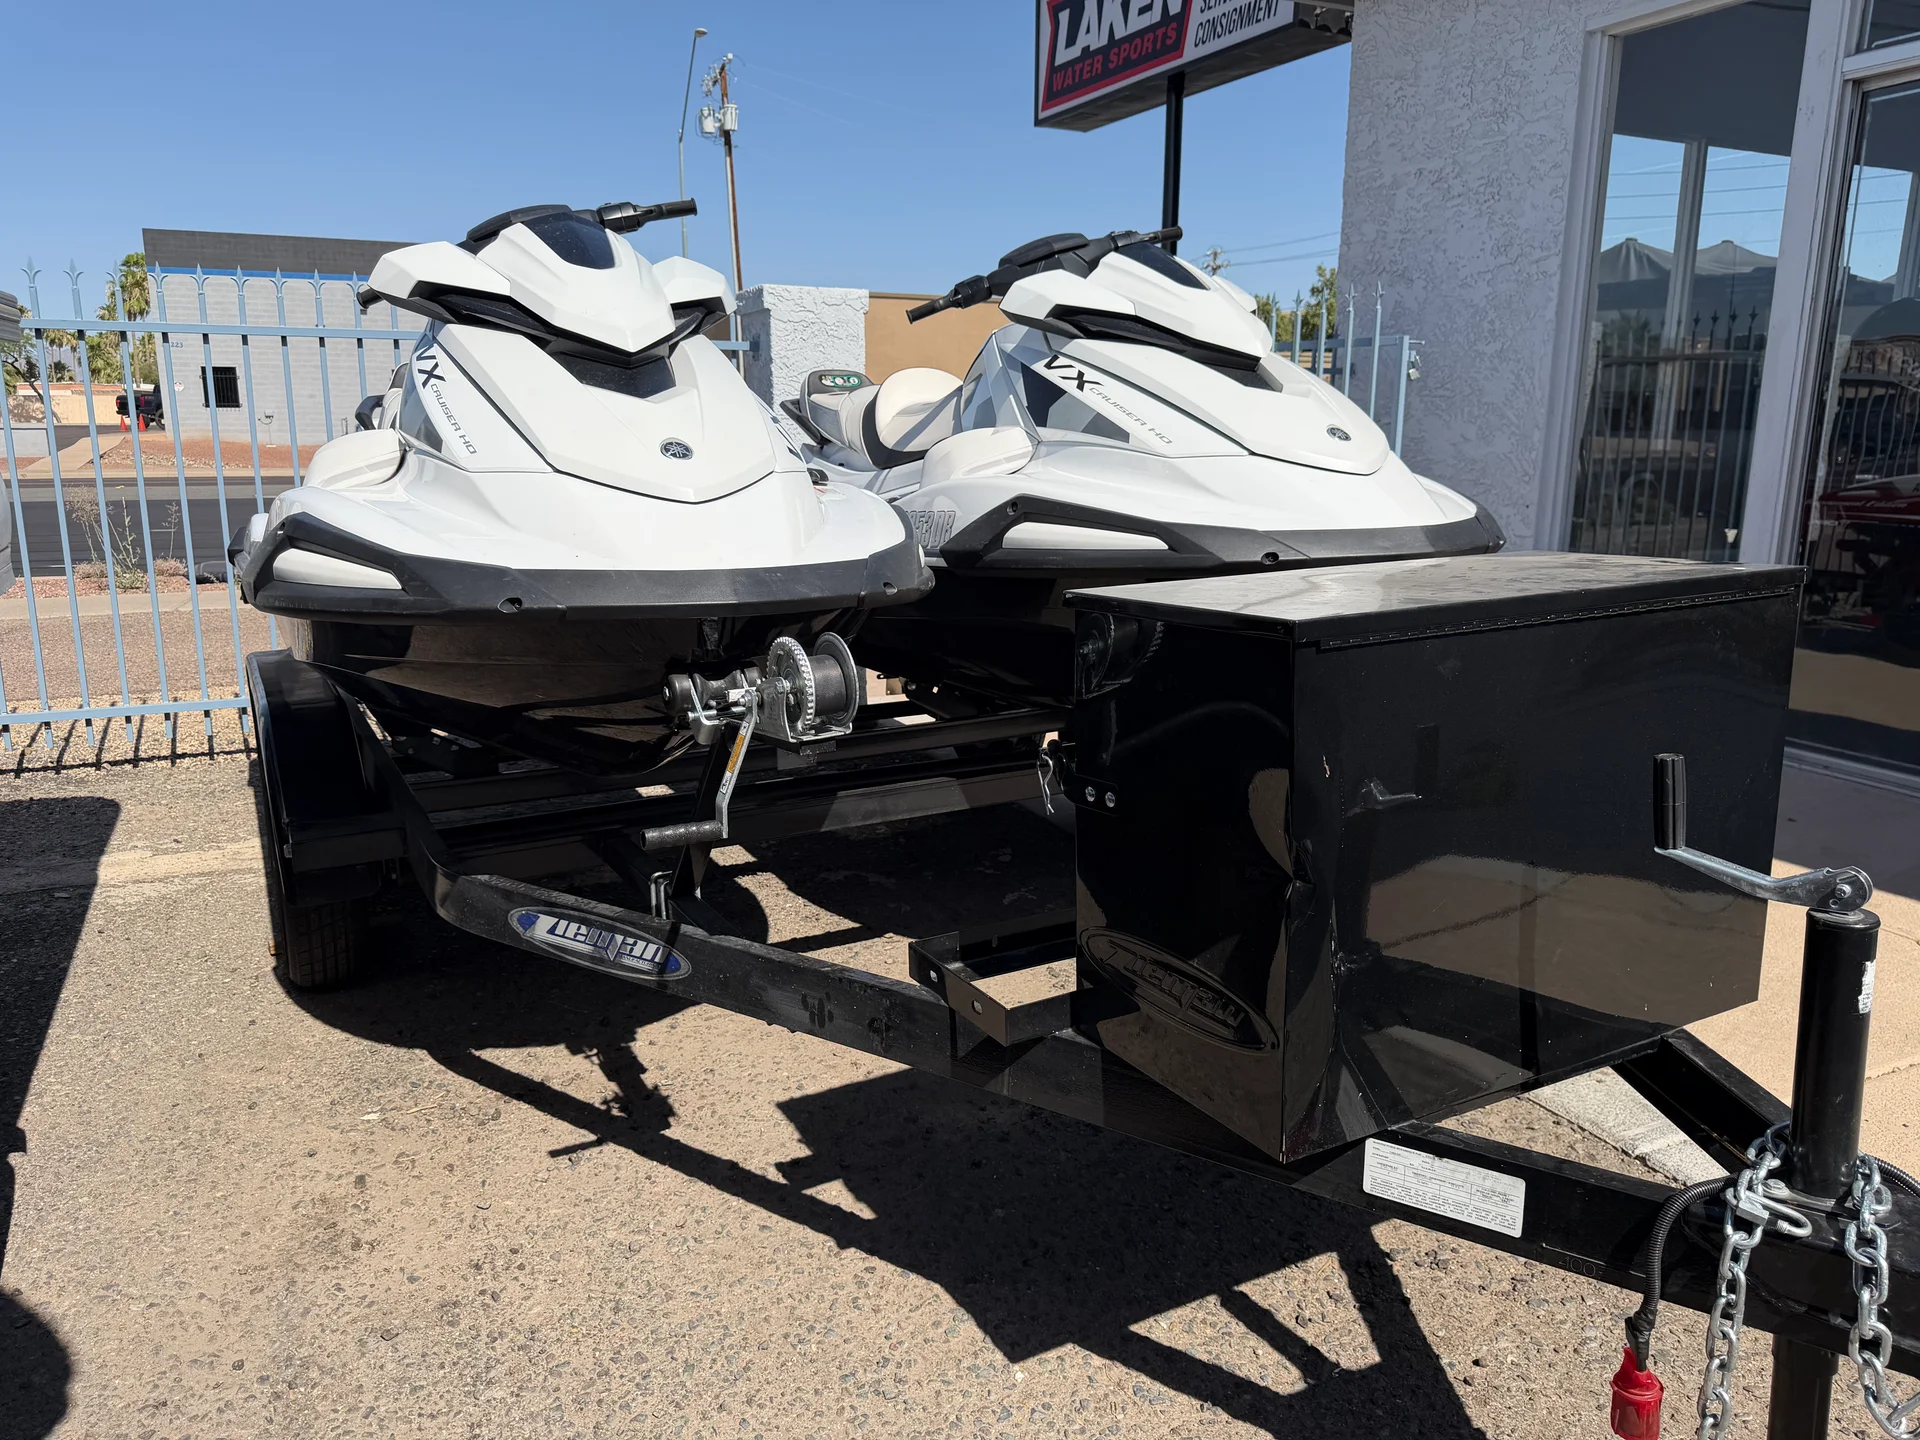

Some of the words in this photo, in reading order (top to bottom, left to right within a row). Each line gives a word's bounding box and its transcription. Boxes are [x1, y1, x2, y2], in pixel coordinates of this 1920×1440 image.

[1194, 0, 1279, 48] CONSIGNMENT
[1053, 54, 1103, 92] WATER
[1108, 22, 1178, 69] SPORTS
[415, 344, 447, 389] VX
[1043, 354, 1105, 392] VX
[430, 383, 461, 432] CRUISER
[1089, 387, 1147, 426] CRUISER
